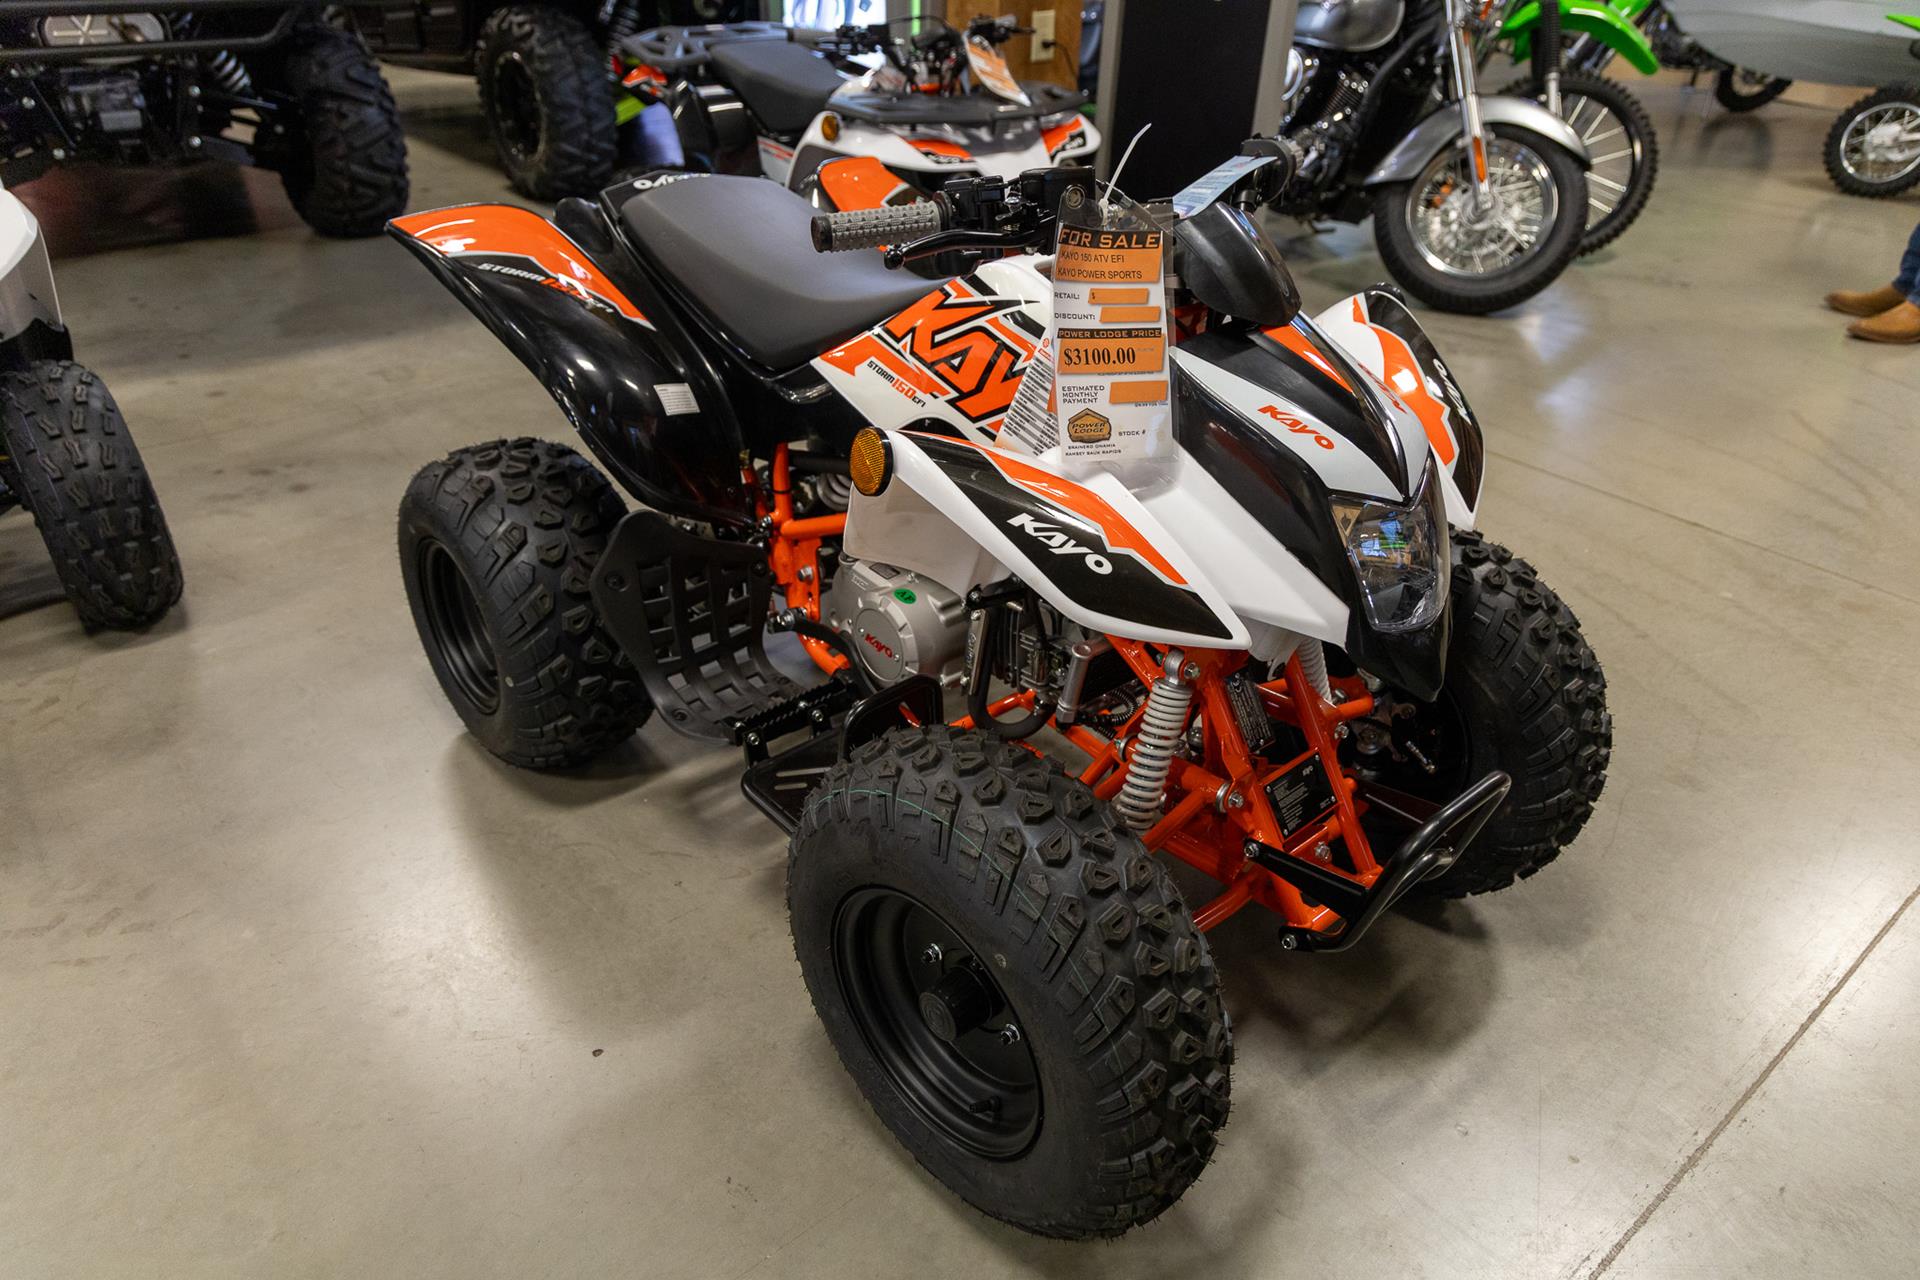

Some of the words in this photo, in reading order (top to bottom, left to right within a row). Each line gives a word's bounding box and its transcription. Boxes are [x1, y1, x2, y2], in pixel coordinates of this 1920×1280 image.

[1059, 228, 1093, 247] FOR
[1099, 233, 1161, 249] SALE
[1061, 250, 1079, 262] KAYO
[1080, 253, 1093, 263] 150
[1094, 254, 1109, 264] ATV
[1111, 254, 1125, 264] EFI
[1057, 268, 1077, 278] KAYO
[1077, 269, 1107, 280] POWER
[1107, 270, 1143, 280] SPORTS
[1054, 291, 1081, 300] RETAIL:
[1054, 312, 1096, 321] DISCOUNT:
[1058, 330, 1091, 339] POWER
[1094, 329, 1129, 339] LODGE
[1131, 329, 1162, 338] PRICE
[882, 287, 1027, 421] KAY
[1063, 346, 1136, 367] $3100.00
[1061, 384, 1105, 392] ESTIMATED
[1071, 421, 1106, 429] POWER
[1256, 404, 1335, 450] KAYO
[1005, 512, 1113, 575] KAYO
[864, 633, 893, 658] KAYO
